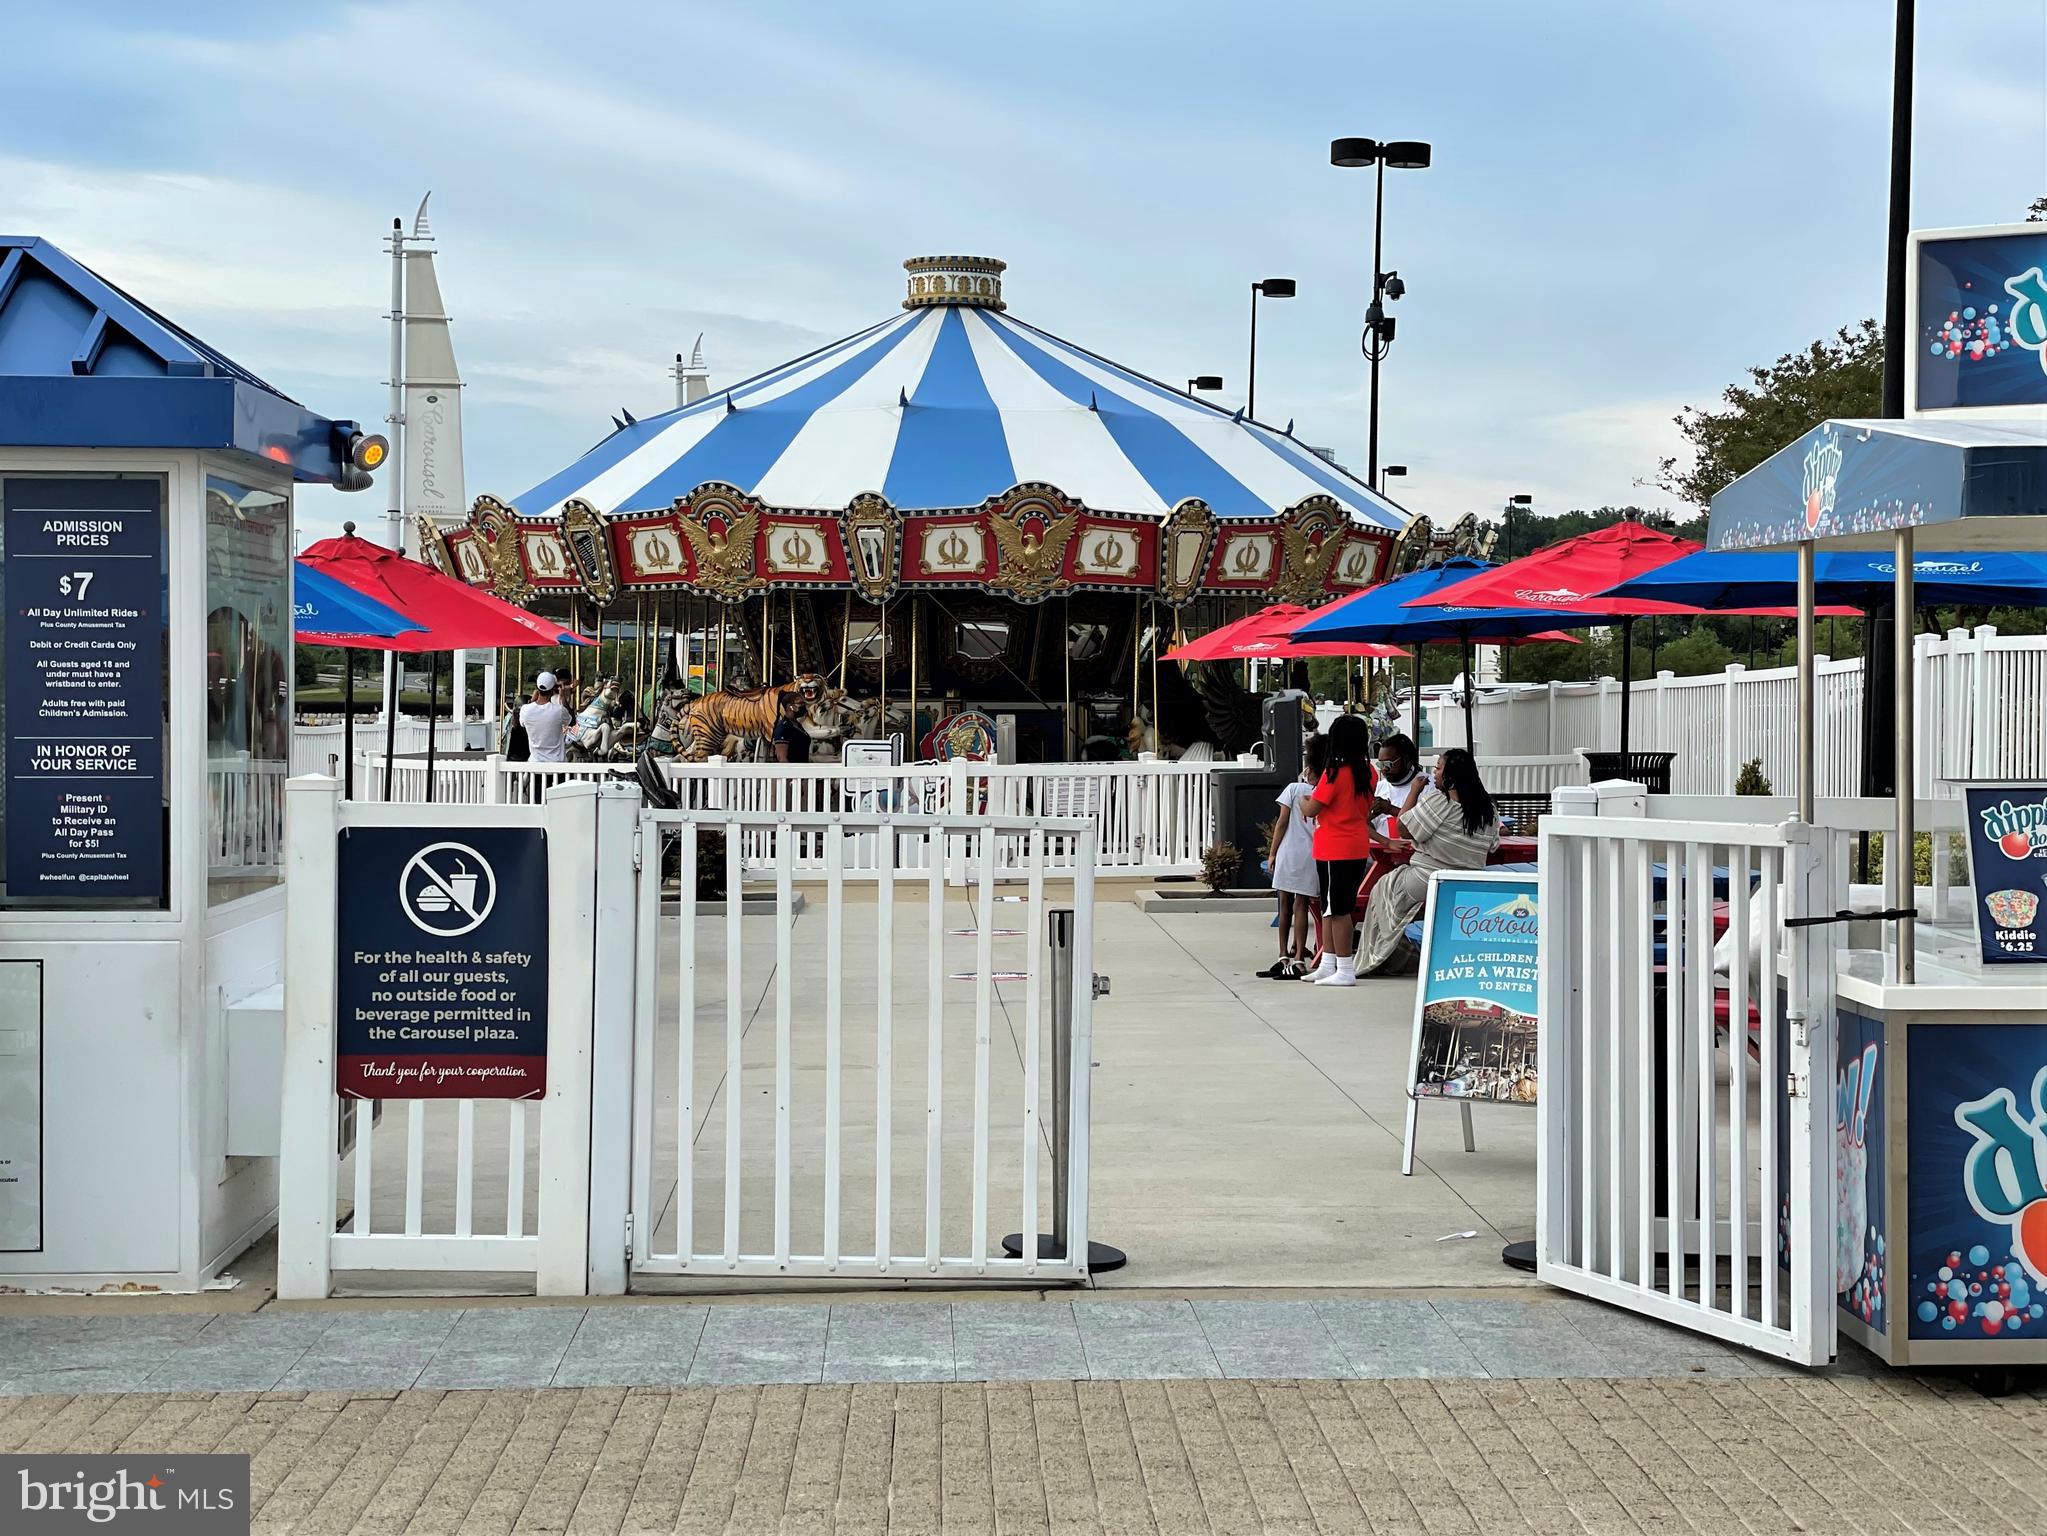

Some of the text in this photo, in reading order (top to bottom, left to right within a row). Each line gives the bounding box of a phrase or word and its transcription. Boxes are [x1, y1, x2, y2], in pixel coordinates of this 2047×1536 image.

[42, 520, 123, 533] ADMISSION
[56, 534, 109, 546] PRICES
[59, 571, 94, 601] $7
[27, 607, 139, 619] All Day Unlimited Rides
[29, 640, 52, 649] Debit
[63, 640, 90, 649] Credit
[90, 640, 116, 649] Cards
[116, 640, 137, 651] Only
[36, 659, 130, 671] All Guests aged 18 and
[45, 670, 71, 678] under
[71, 670, 93, 678] must
[94, 670, 114, 678] have
[45, 679, 122, 688] wristband to enter.
[41, 699, 126, 709] Adults free with paid
[38, 709, 129, 717] Children's Admission.
[37, 745, 131, 757] IN HONOR OF
[30, 758, 137, 771] YOUR SERVICE
[65, 793, 103, 803] Present
[60, 804, 108, 816] Military ID
[52, 817, 63, 825] to
[64, 816, 102, 825] Receive
[54, 827, 114, 839] All Day Pass
[1995, 930, 2037, 941] Kiddie
[1999, 941, 2034, 952] $6.25
[354, 950, 532, 968] For the health & safety
[1453, 953, 1475, 964] ALL
[1477, 952, 1534, 965] CHILDREN
[379, 969, 509, 986] of all our guests,
[1434, 966, 1474, 983] HAVE
[1477, 966, 1488, 978] A
[1478, 981, 1533, 993] TO ENTER
[371, 987, 517, 1002] no outside food or
[355, 1006, 531, 1024] beverage permitted in
[368, 1025, 519, 1042] the Carousel plaza.
[360, 1061, 528, 1085] Thank you for your cooperation.
